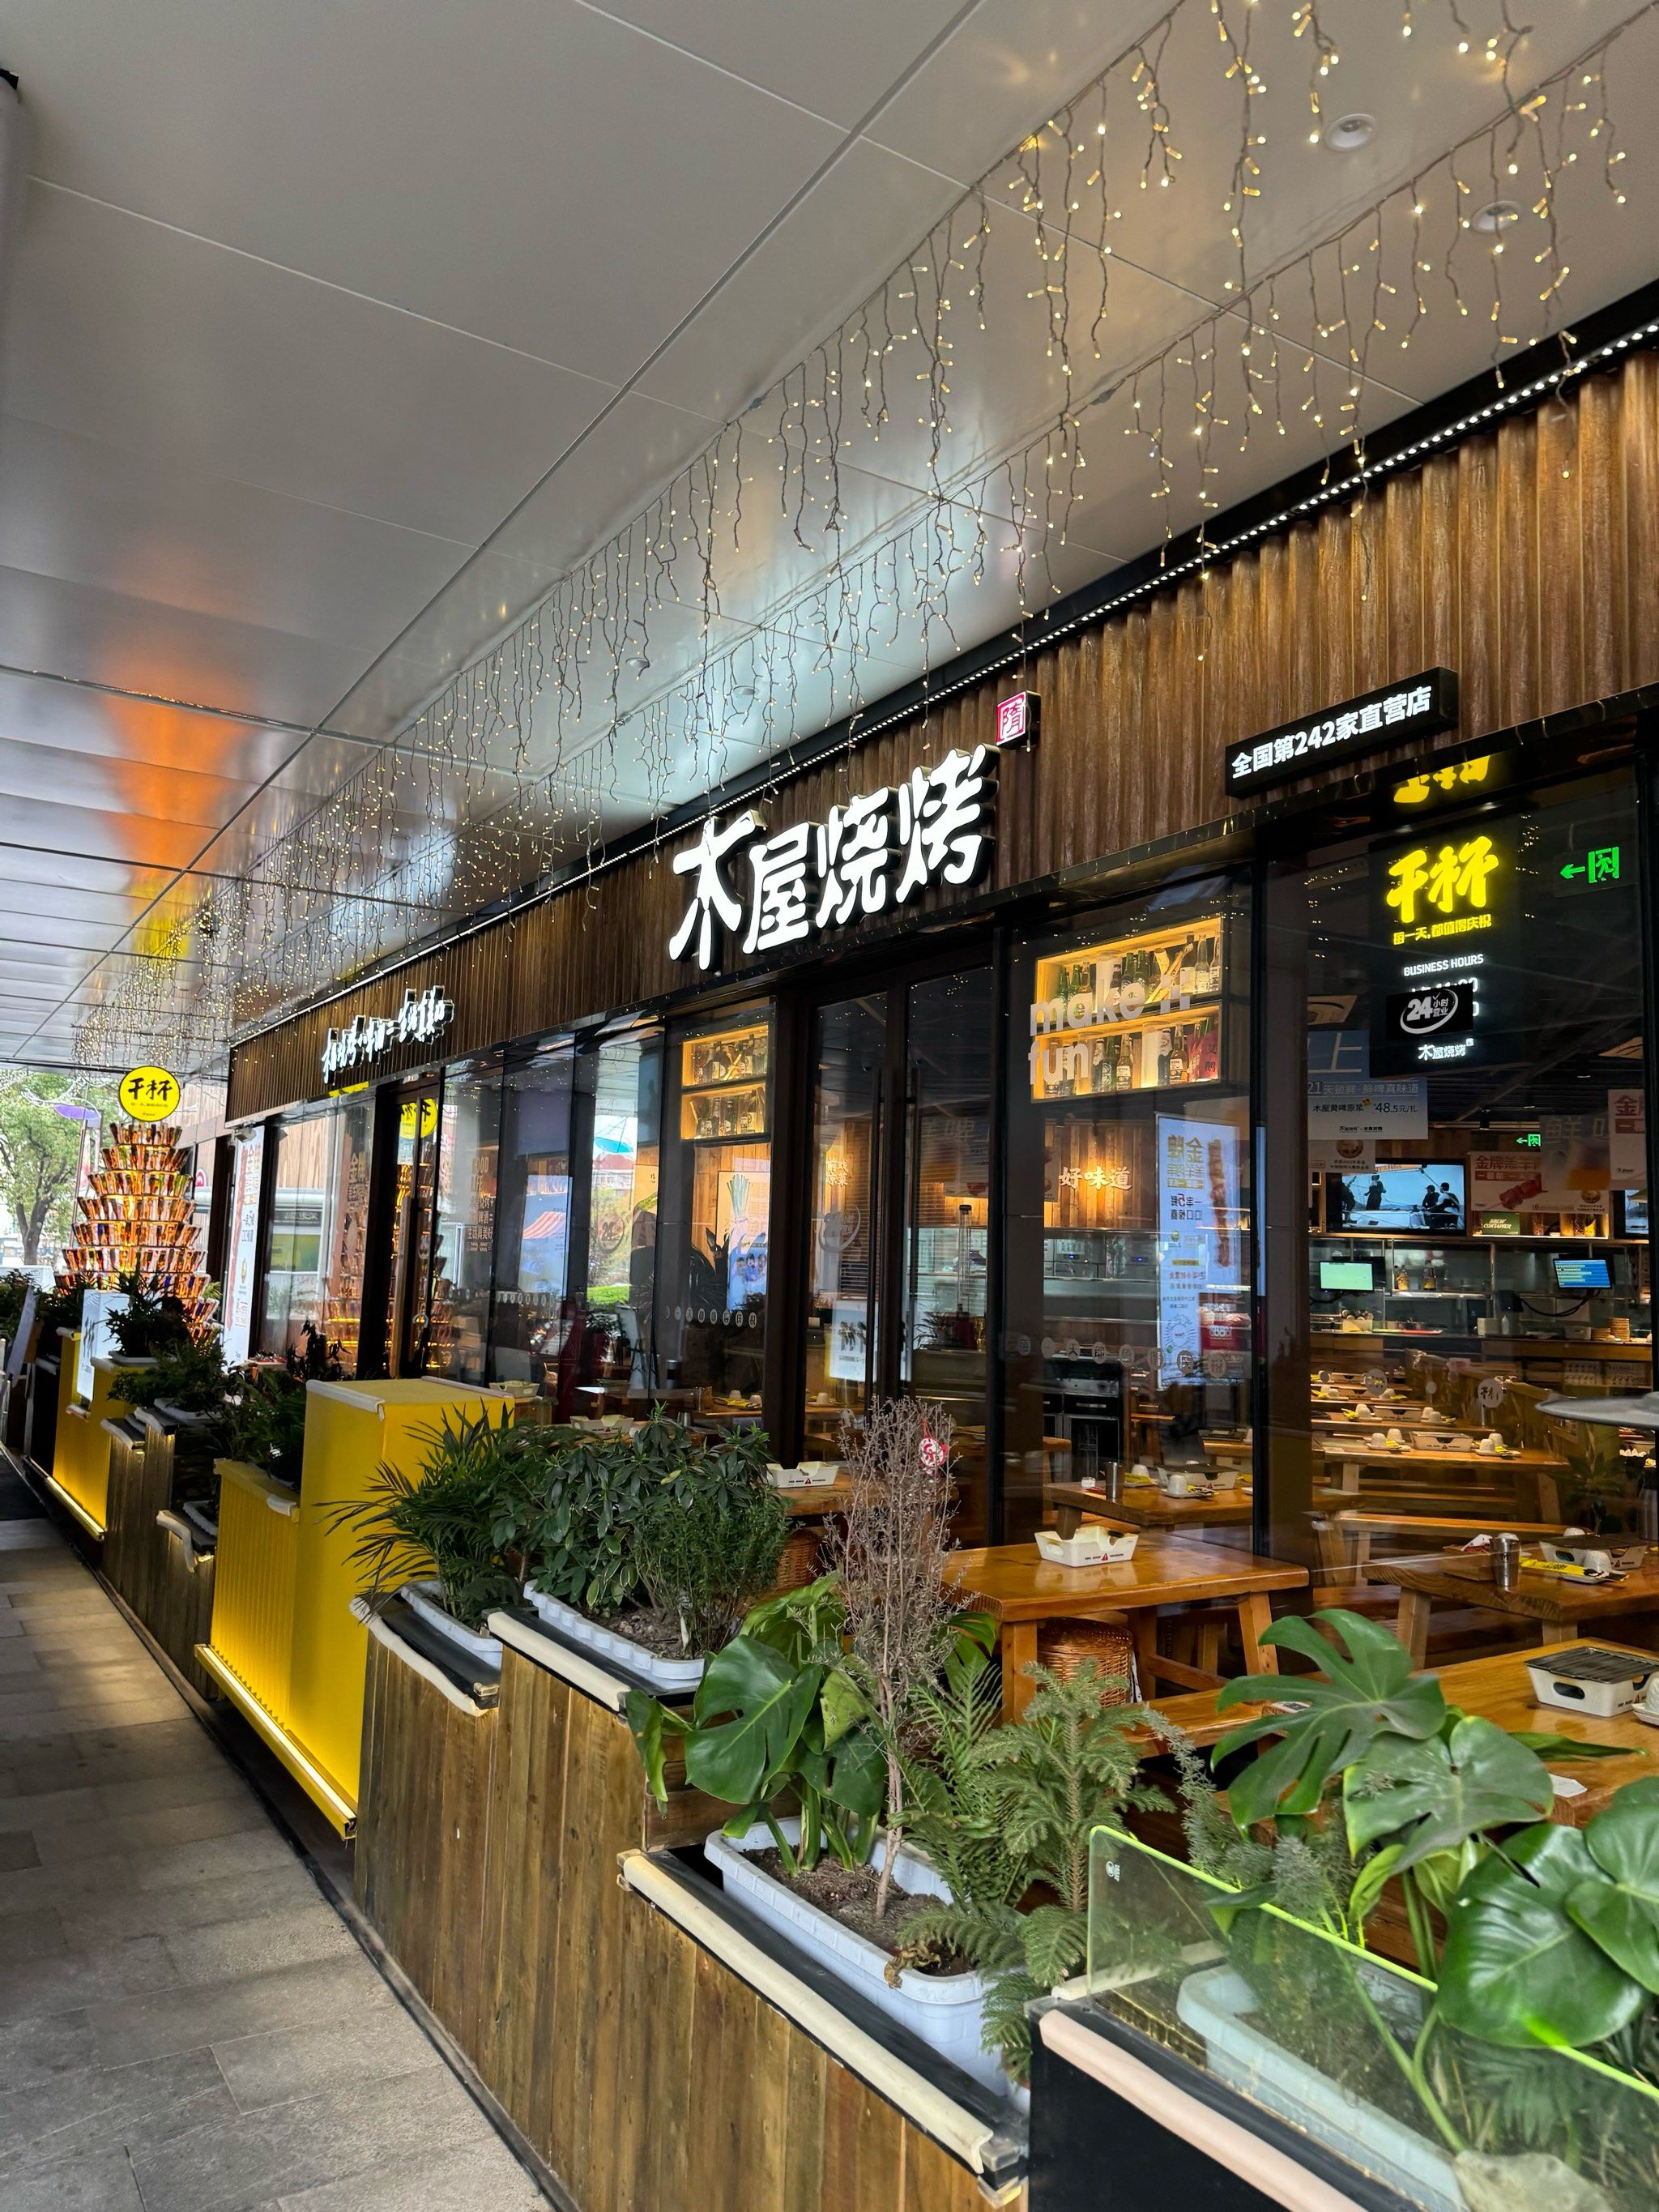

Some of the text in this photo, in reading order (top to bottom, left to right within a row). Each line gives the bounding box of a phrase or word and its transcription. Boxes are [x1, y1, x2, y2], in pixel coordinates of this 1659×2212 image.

[1231, 685, 1433, 780] 全国第242家直营店
[668, 744, 987, 971] 木屋烧烤
[1386, 835, 1500, 924] 干杯
[1403, 953, 1484, 977] BUSINESS HOURS
[1030, 979, 1145, 1037] make
[1406, 996, 1433, 1022] 24
[1432, 997, 1449, 1009] 小时
[1432, 1007, 1449, 1018] 营业
[1028, 1040, 1089, 1086] fun
[1418, 1044, 1467, 1061] 木屋烧烤
[127, 1077, 173, 1102] 干杯
[1058, 1166, 1132, 1190] 好味道
